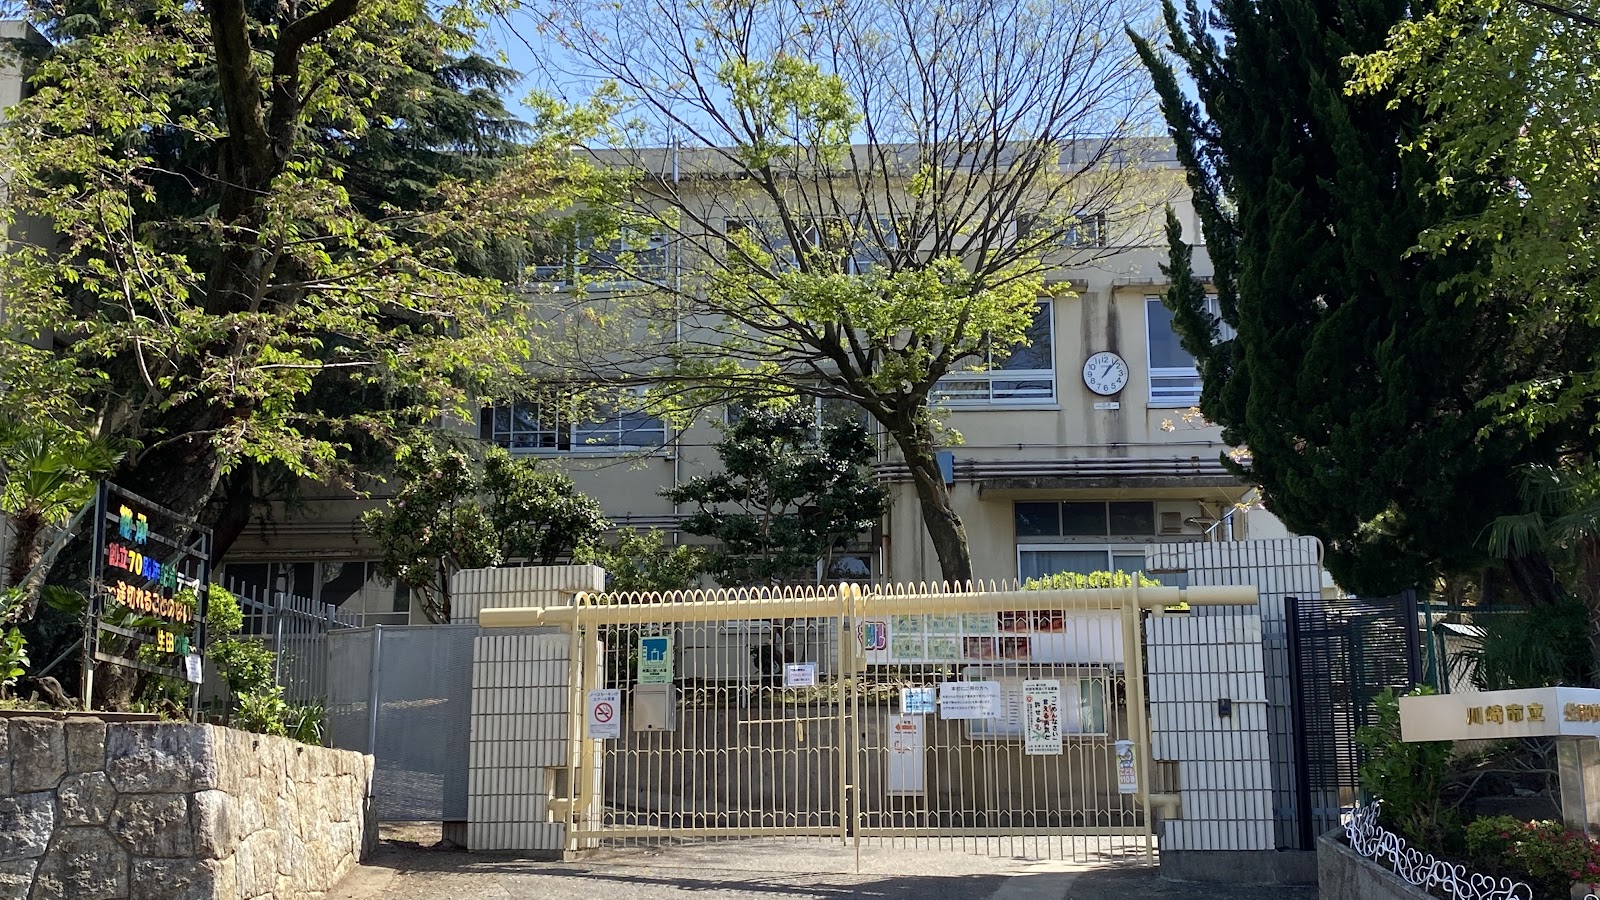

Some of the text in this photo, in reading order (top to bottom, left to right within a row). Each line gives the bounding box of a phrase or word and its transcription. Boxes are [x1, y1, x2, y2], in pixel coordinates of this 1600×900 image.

[1042, 698, 1051, 741] 言える勇気と
[1466, 702, 1546, 725] 川崎市立
[1120, 768, 1134, 776] こども
